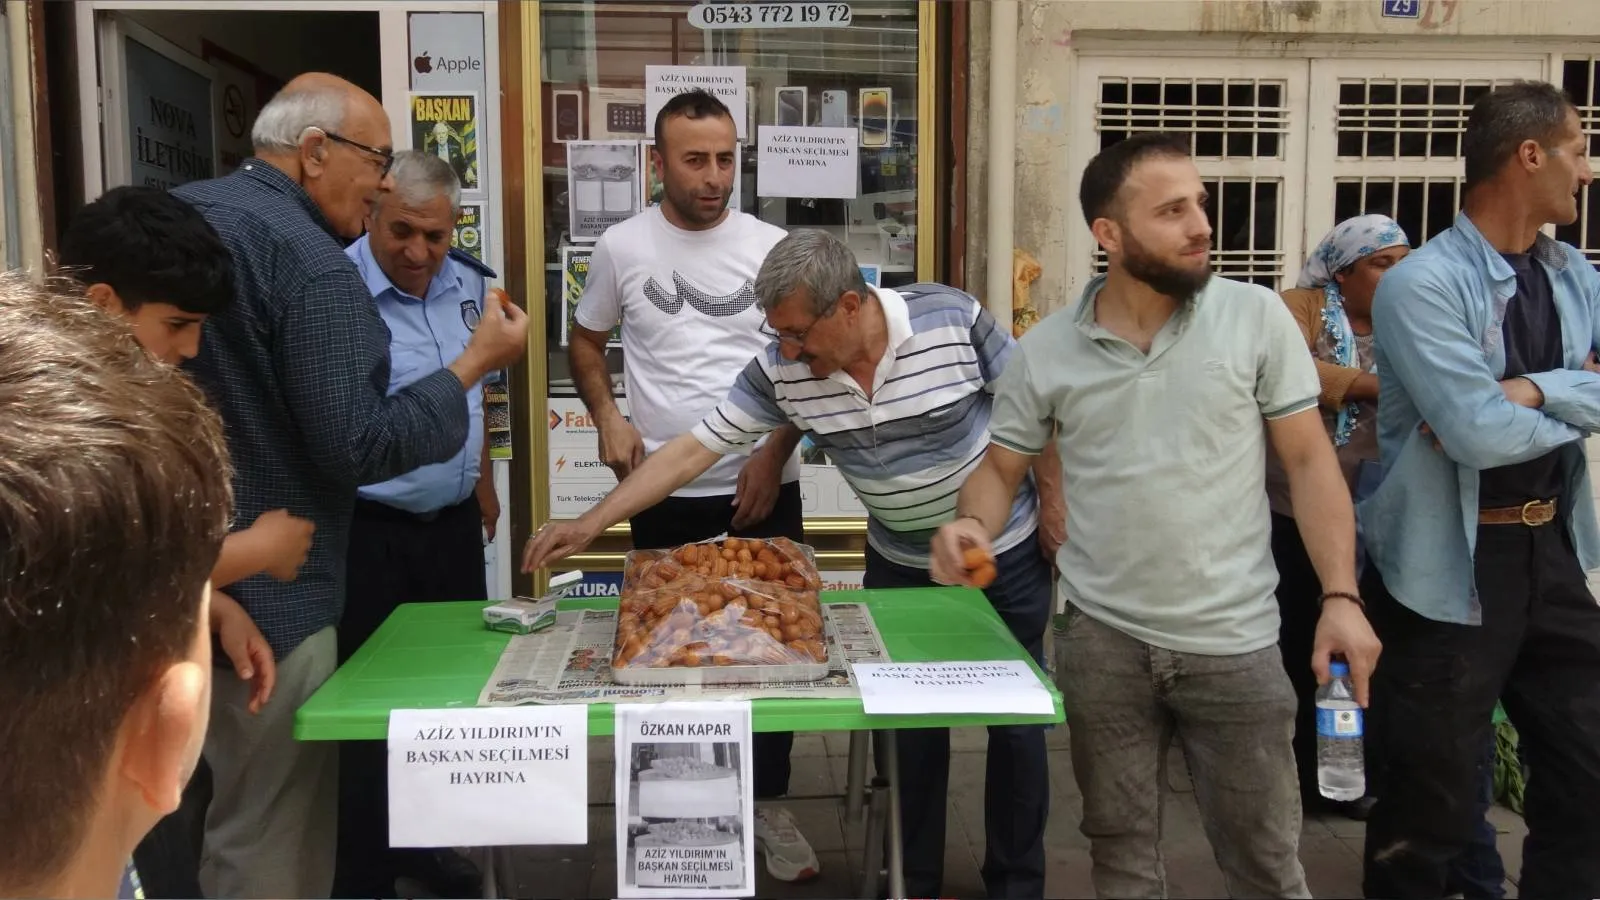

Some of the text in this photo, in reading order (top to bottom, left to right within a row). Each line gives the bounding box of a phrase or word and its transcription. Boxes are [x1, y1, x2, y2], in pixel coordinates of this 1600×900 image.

[702, 5, 849, 23] 0543 772 19 72
[436, 56, 481, 73] Apple
[660, 73, 734, 84] AZİZ YILDIRIM'IN
[655, 86, 689, 94] BAŞKAN
[149, 95, 197, 140] NOVA
[772, 134, 846, 144] AZİZ YILDIRIM'IN
[767, 146, 849, 156] BAŞKAN SEÇİLMESİ
[788, 158, 827, 167] HAYRINA
[571, 256, 592, 264] FENER
[574, 263, 589, 273] YEN
[565, 411, 595, 428] Fat
[566, 583, 620, 596] ATURA
[414, 725, 563, 741] AZİZ YILDIRIM'IN
[640, 721, 732, 736] ÖZKAN KAPAR
[406, 745, 570, 765] BAŞKAN SEÇİLMESİ
[449, 771, 527, 785] HAYRINA
[644, 847, 728, 859] AZİZ YILDIRIM'IN
[638, 860, 734, 873] BAŞKAN SEÇİLMESİ
[663, 874, 708, 884] HAYRINA
